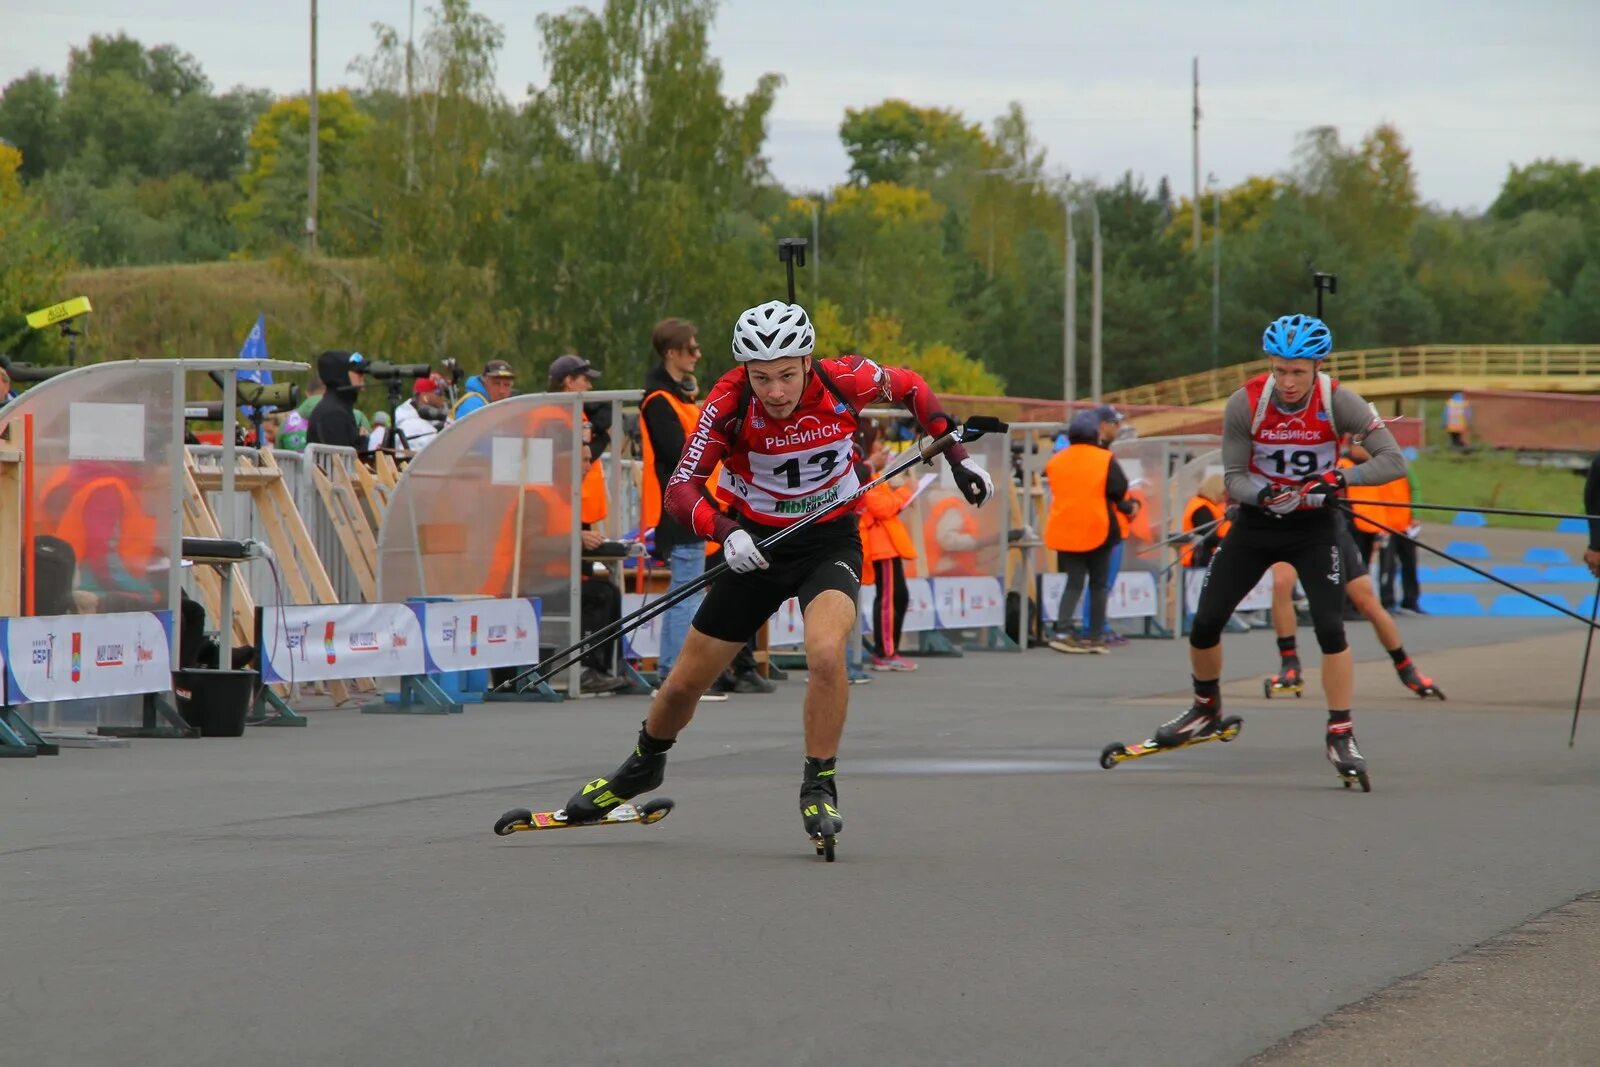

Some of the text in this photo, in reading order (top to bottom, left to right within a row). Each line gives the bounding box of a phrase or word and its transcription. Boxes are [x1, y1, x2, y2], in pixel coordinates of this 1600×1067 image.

[765, 422, 842, 449] РЫБИНСК
[1260, 429, 1321, 440] РЫБИНСК
[773, 450, 840, 489] 13
[1266, 449, 1318, 476] 19
